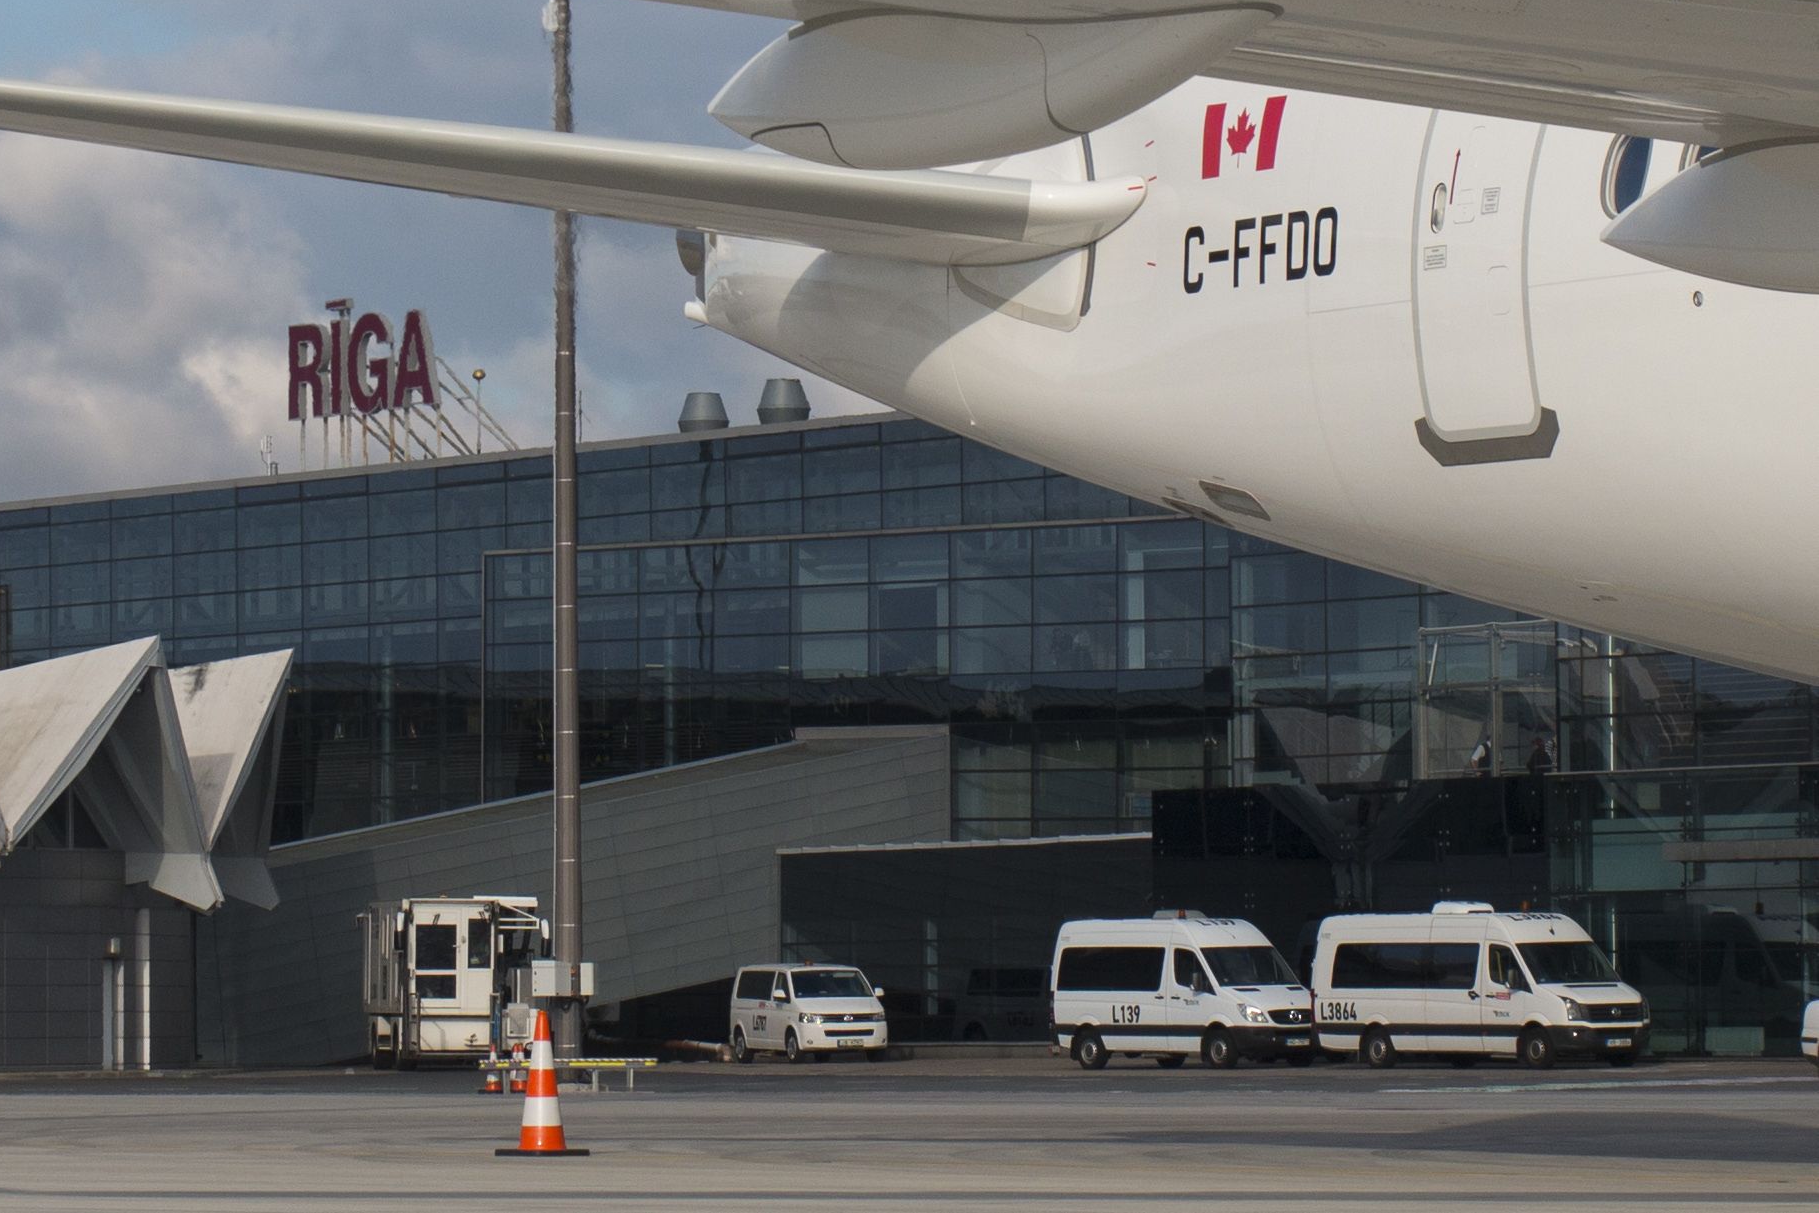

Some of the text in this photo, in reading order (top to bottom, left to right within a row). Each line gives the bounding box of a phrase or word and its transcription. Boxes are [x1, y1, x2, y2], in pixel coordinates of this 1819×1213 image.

[1183, 206, 1338, 294] C-FFDO
[288, 298, 439, 421] RĪGA
[1112, 1004, 1141, 1023] L139
[1320, 1001, 1357, 1021] L3864
